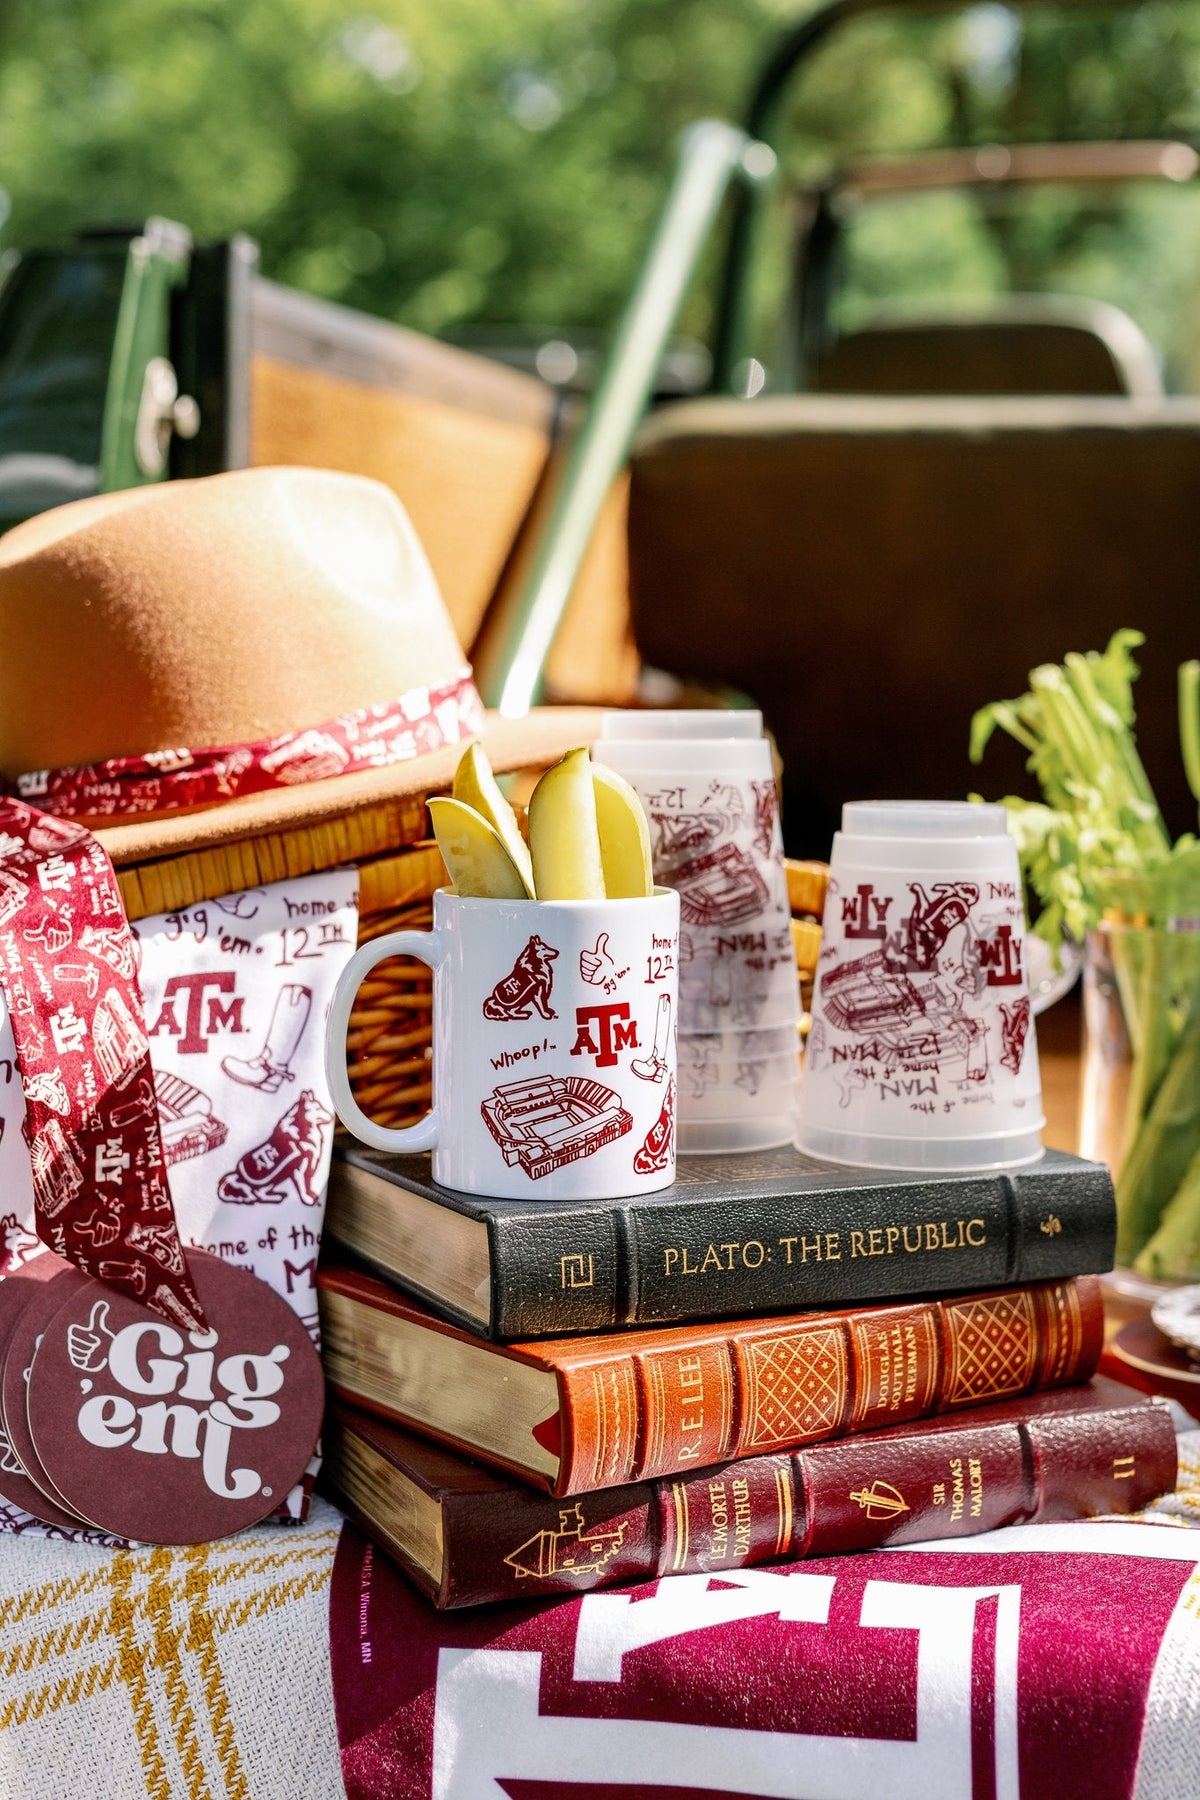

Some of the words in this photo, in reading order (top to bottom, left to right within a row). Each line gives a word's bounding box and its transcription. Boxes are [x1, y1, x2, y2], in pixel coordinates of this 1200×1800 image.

[283, 897, 336, 919] home
[258, 1226, 278, 1251] of
[663, 1240, 773, 1276] PLATO:
[779, 1232, 841, 1265] THE
[849, 1218, 987, 1259] REPUBLIC
[108, 1321, 290, 1428] Gig
[877, 1330, 890, 1408] DOUGLAS
[890, 1324, 904, 1411] SOUTHALL
[904, 1326, 918, 1403] FREEMAN
[708, 1481, 728, 1543] MORTE
[932, 1482, 946, 1505] SIR
[949, 1458, 964, 1522] THOMAS
[968, 1458, 983, 1518] MALORY
[710, 1544, 728, 1560] LE
[361, 1641, 373, 1664] MN
